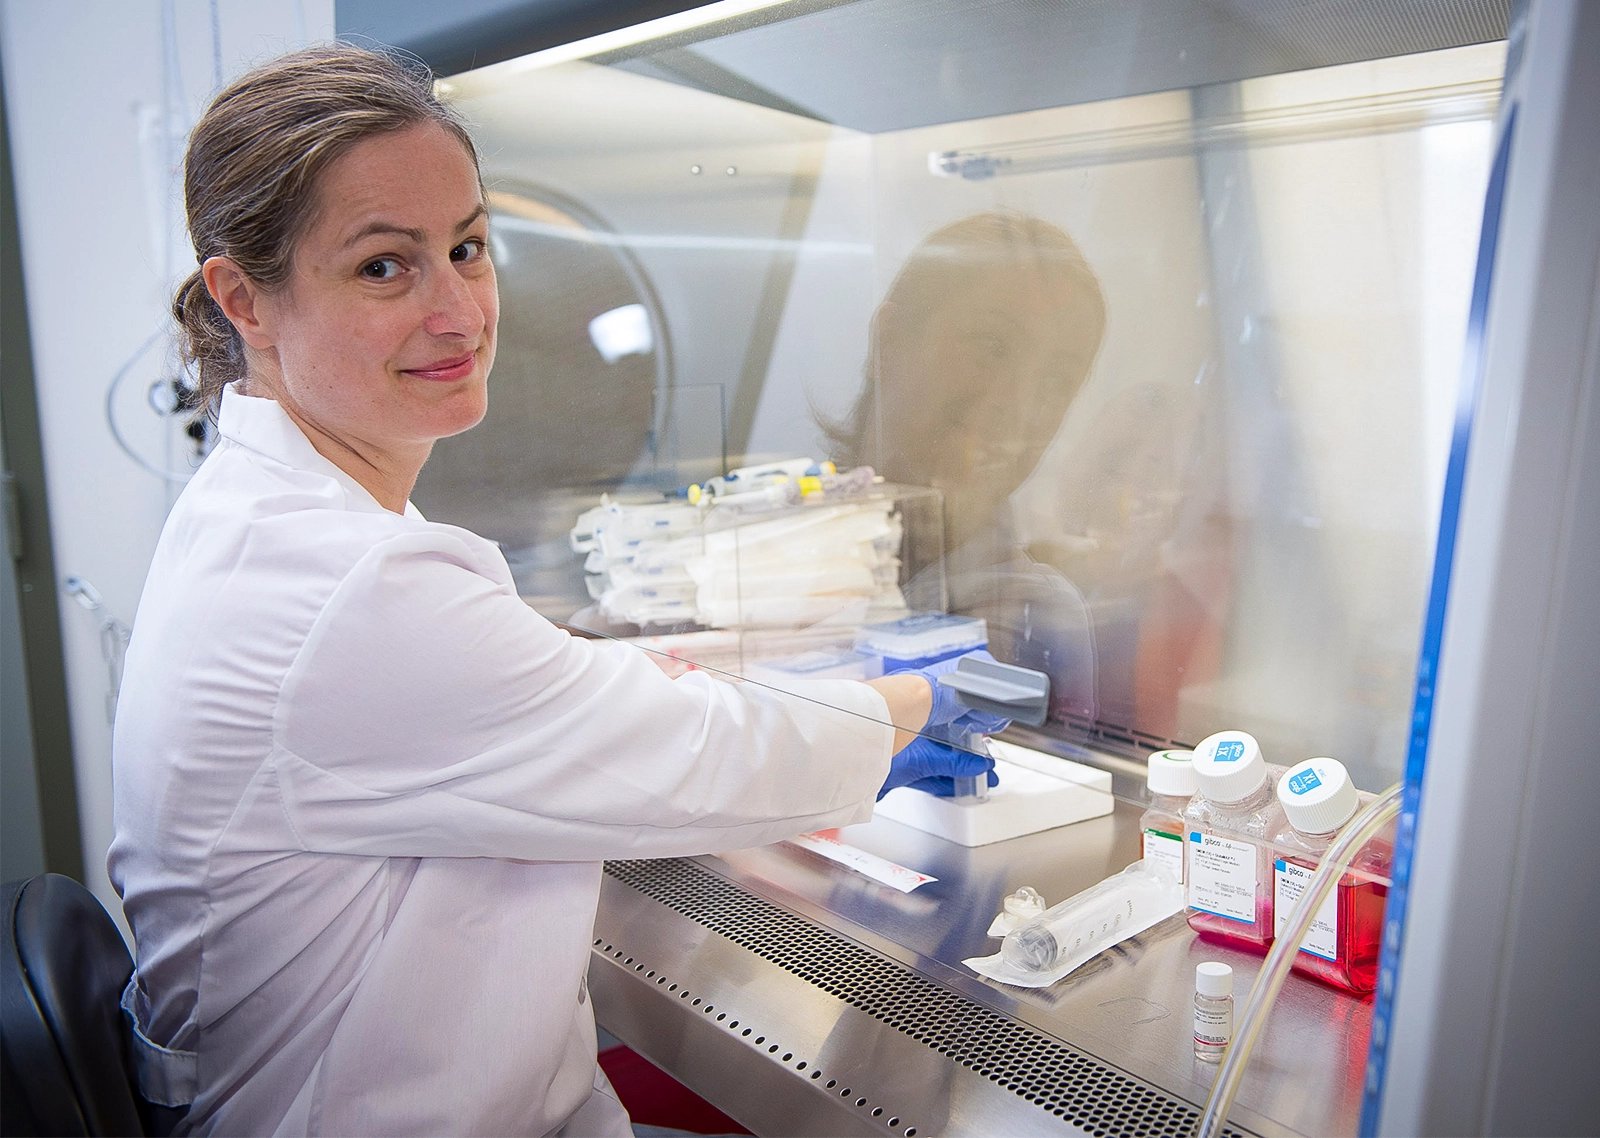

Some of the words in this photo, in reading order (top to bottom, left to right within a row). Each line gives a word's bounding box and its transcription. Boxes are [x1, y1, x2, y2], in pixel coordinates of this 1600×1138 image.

[1217, 746, 1229, 756] 1X
[1303, 773, 1316, 784] 1X
[1204, 837, 1221, 847] gibco
[1288, 867, 1304, 878] gibco
